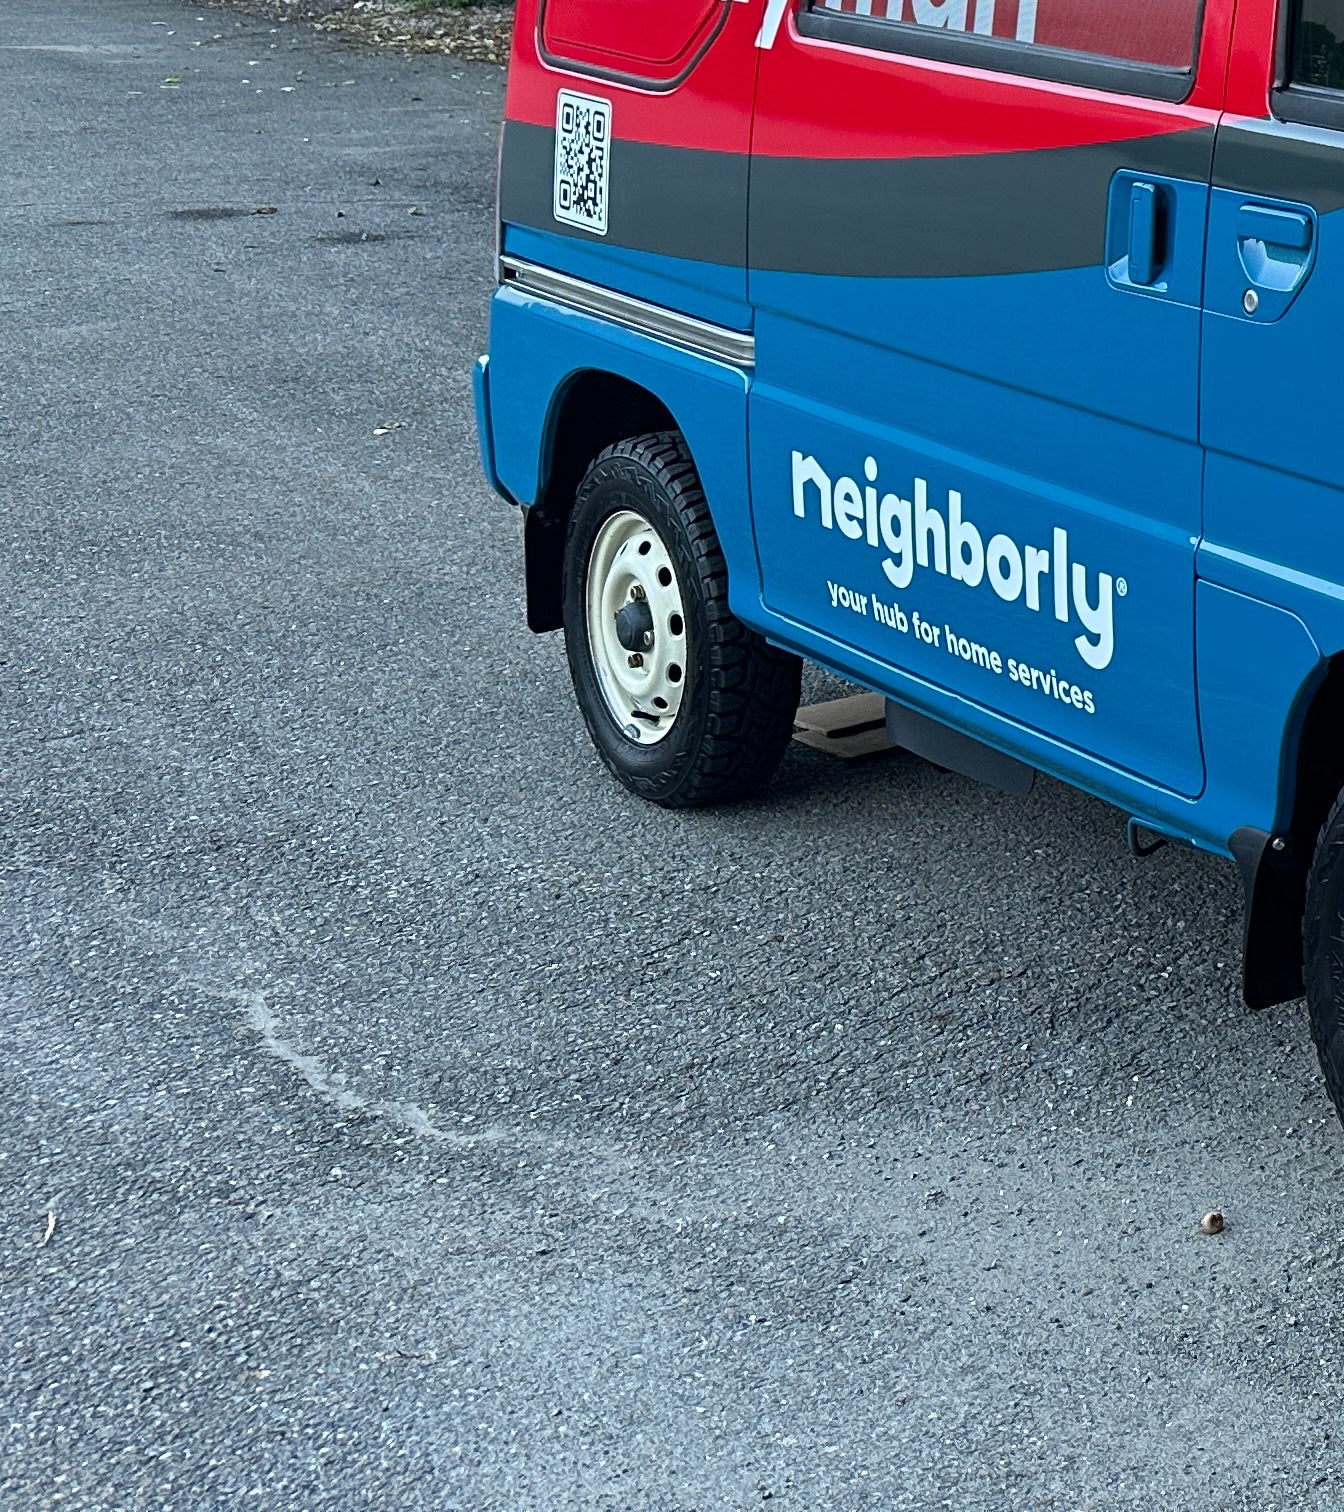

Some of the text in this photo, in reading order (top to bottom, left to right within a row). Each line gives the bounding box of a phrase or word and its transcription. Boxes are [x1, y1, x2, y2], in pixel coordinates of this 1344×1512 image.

[826, 579, 1096, 715] your hub for home services
